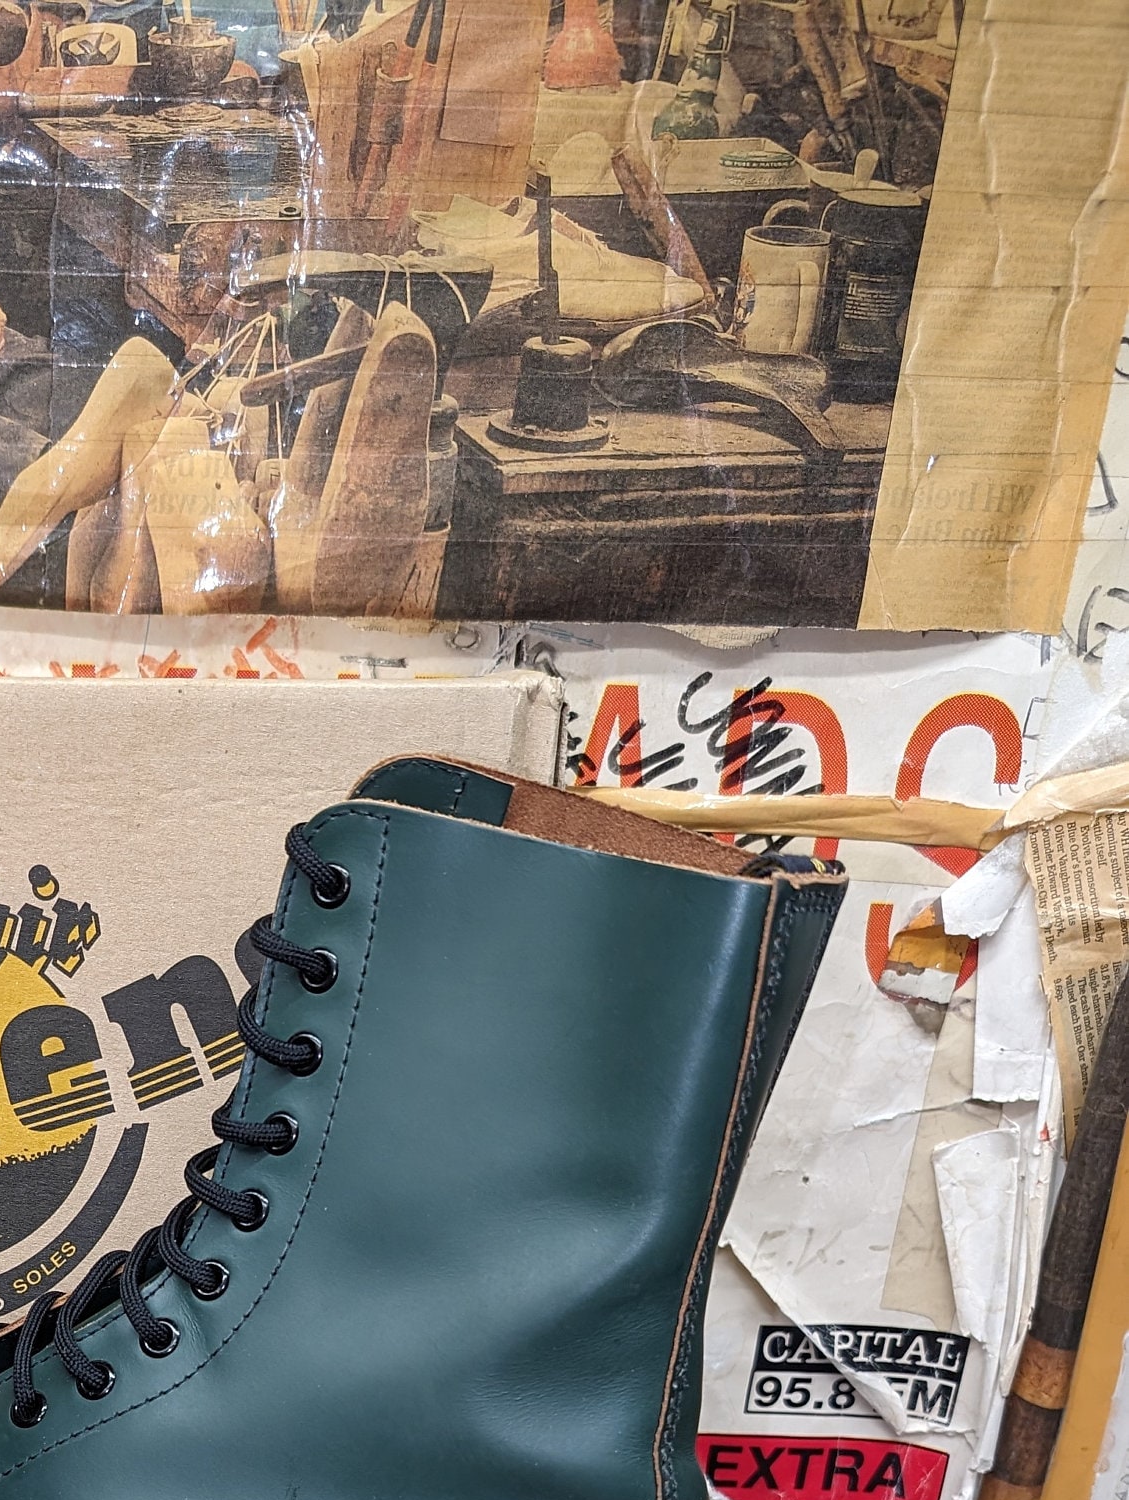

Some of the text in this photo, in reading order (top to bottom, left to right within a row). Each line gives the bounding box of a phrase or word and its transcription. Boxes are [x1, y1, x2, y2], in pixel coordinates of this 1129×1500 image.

[1029, 830, 1041, 861] known
[1080, 825, 1091, 859] Evolve,
[1095, 843, 1107, 869] itself.
[1034, 863, 1043, 874] in
[1036, 874, 1046, 890] the
[1047, 864, 1060, 900] Edward
[1054, 824, 1076, 927] Oliver Vaughan and its
[1067, 821, 1077, 843] Blue
[1073, 870, 1084, 902] former
[1079, 903, 1091, 944] chairman
[1111, 858, 1123, 891] subject
[1038, 890, 1048, 910] City
[1085, 867, 1101, 919] consortium
[1045, 935, 1058, 965] Death,
[1095, 932, 1106, 943] by
[1065, 974, 1078, 1004] valued
[1077, 976, 1087, 995] The
[1088, 968, 1100, 994] single
[1070, 1004, 1080, 1024] each
[1080, 995, 1091, 1015] cash
[1073, 1024, 1083, 1045] Blue
[1083, 1015, 1094, 1032] and
[1077, 1045, 1086, 1062] Oar
[12, 1241, 77, 1294] SOLES
[762, 1330, 961, 1373] CAPITAL
[754, 1375, 856, 1410] 95.8
[705, 1444, 906, 1499] EXTRA
